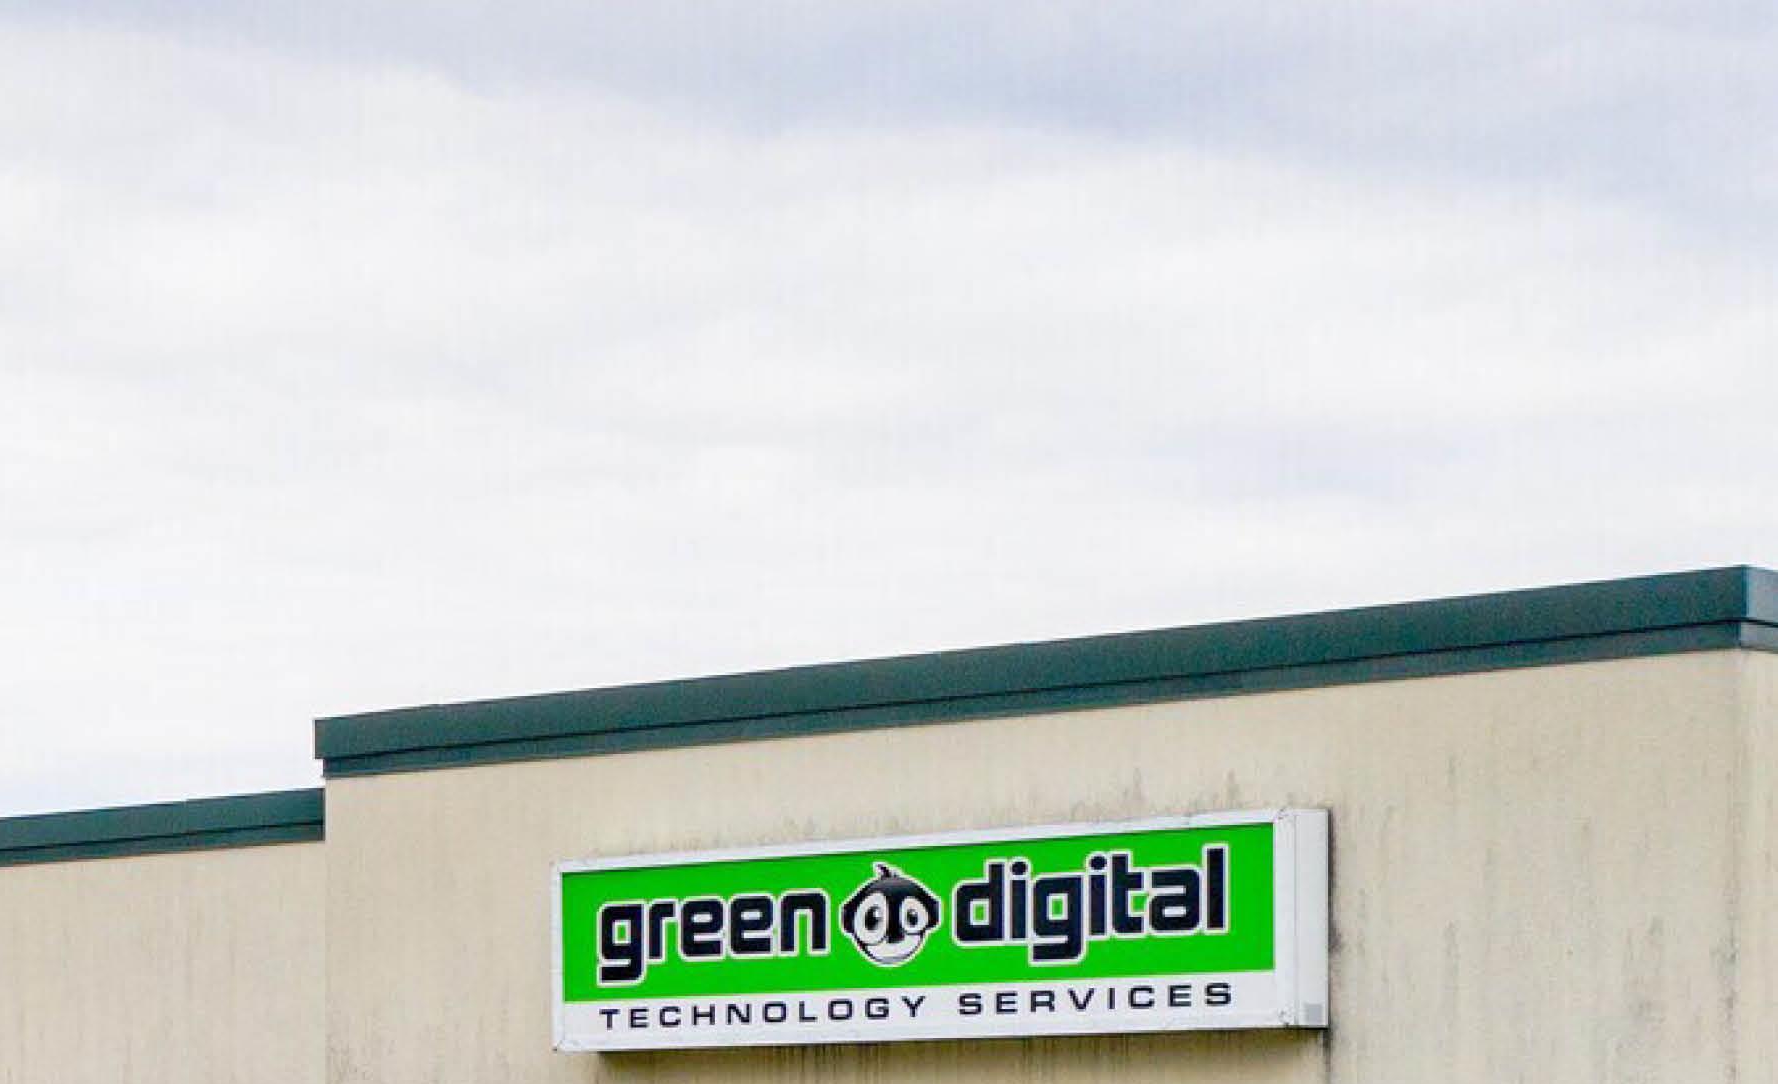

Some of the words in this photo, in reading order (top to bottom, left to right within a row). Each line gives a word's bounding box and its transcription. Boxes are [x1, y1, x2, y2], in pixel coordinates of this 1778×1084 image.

[598, 889, 827, 985] green
[955, 843, 1229, 966] digital
[599, 994, 927, 1031] TECHNOLOGY
[957, 982, 1233, 1016] SERVICES
